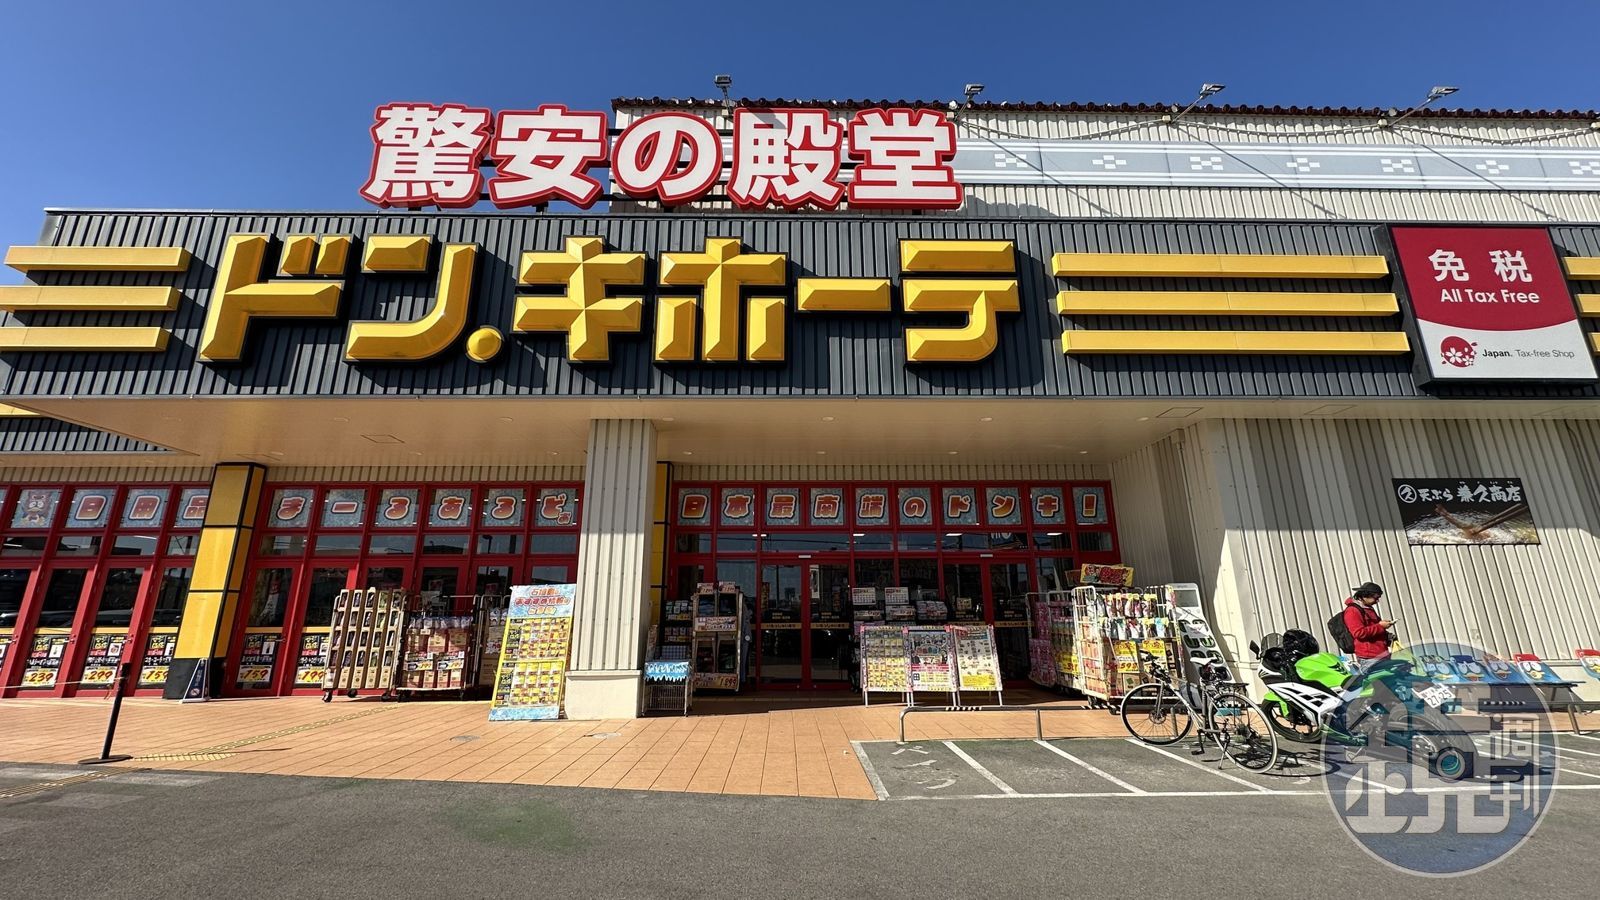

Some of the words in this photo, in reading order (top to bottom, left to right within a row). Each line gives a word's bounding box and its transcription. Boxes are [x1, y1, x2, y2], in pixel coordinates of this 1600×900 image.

[361, 103, 962, 209] 驚安の殿堂
[1440, 289, 1463, 303] All
[1465, 289, 1496, 304] Tax
[1501, 290, 1541, 304] Free
[1516, 348, 1551, 359] Tax-free
[1552, 348, 1576, 360] Shop
[29, 672, 54, 682] 239
[88, 670, 113, 680] 299
[244, 669, 268, 680] 159
